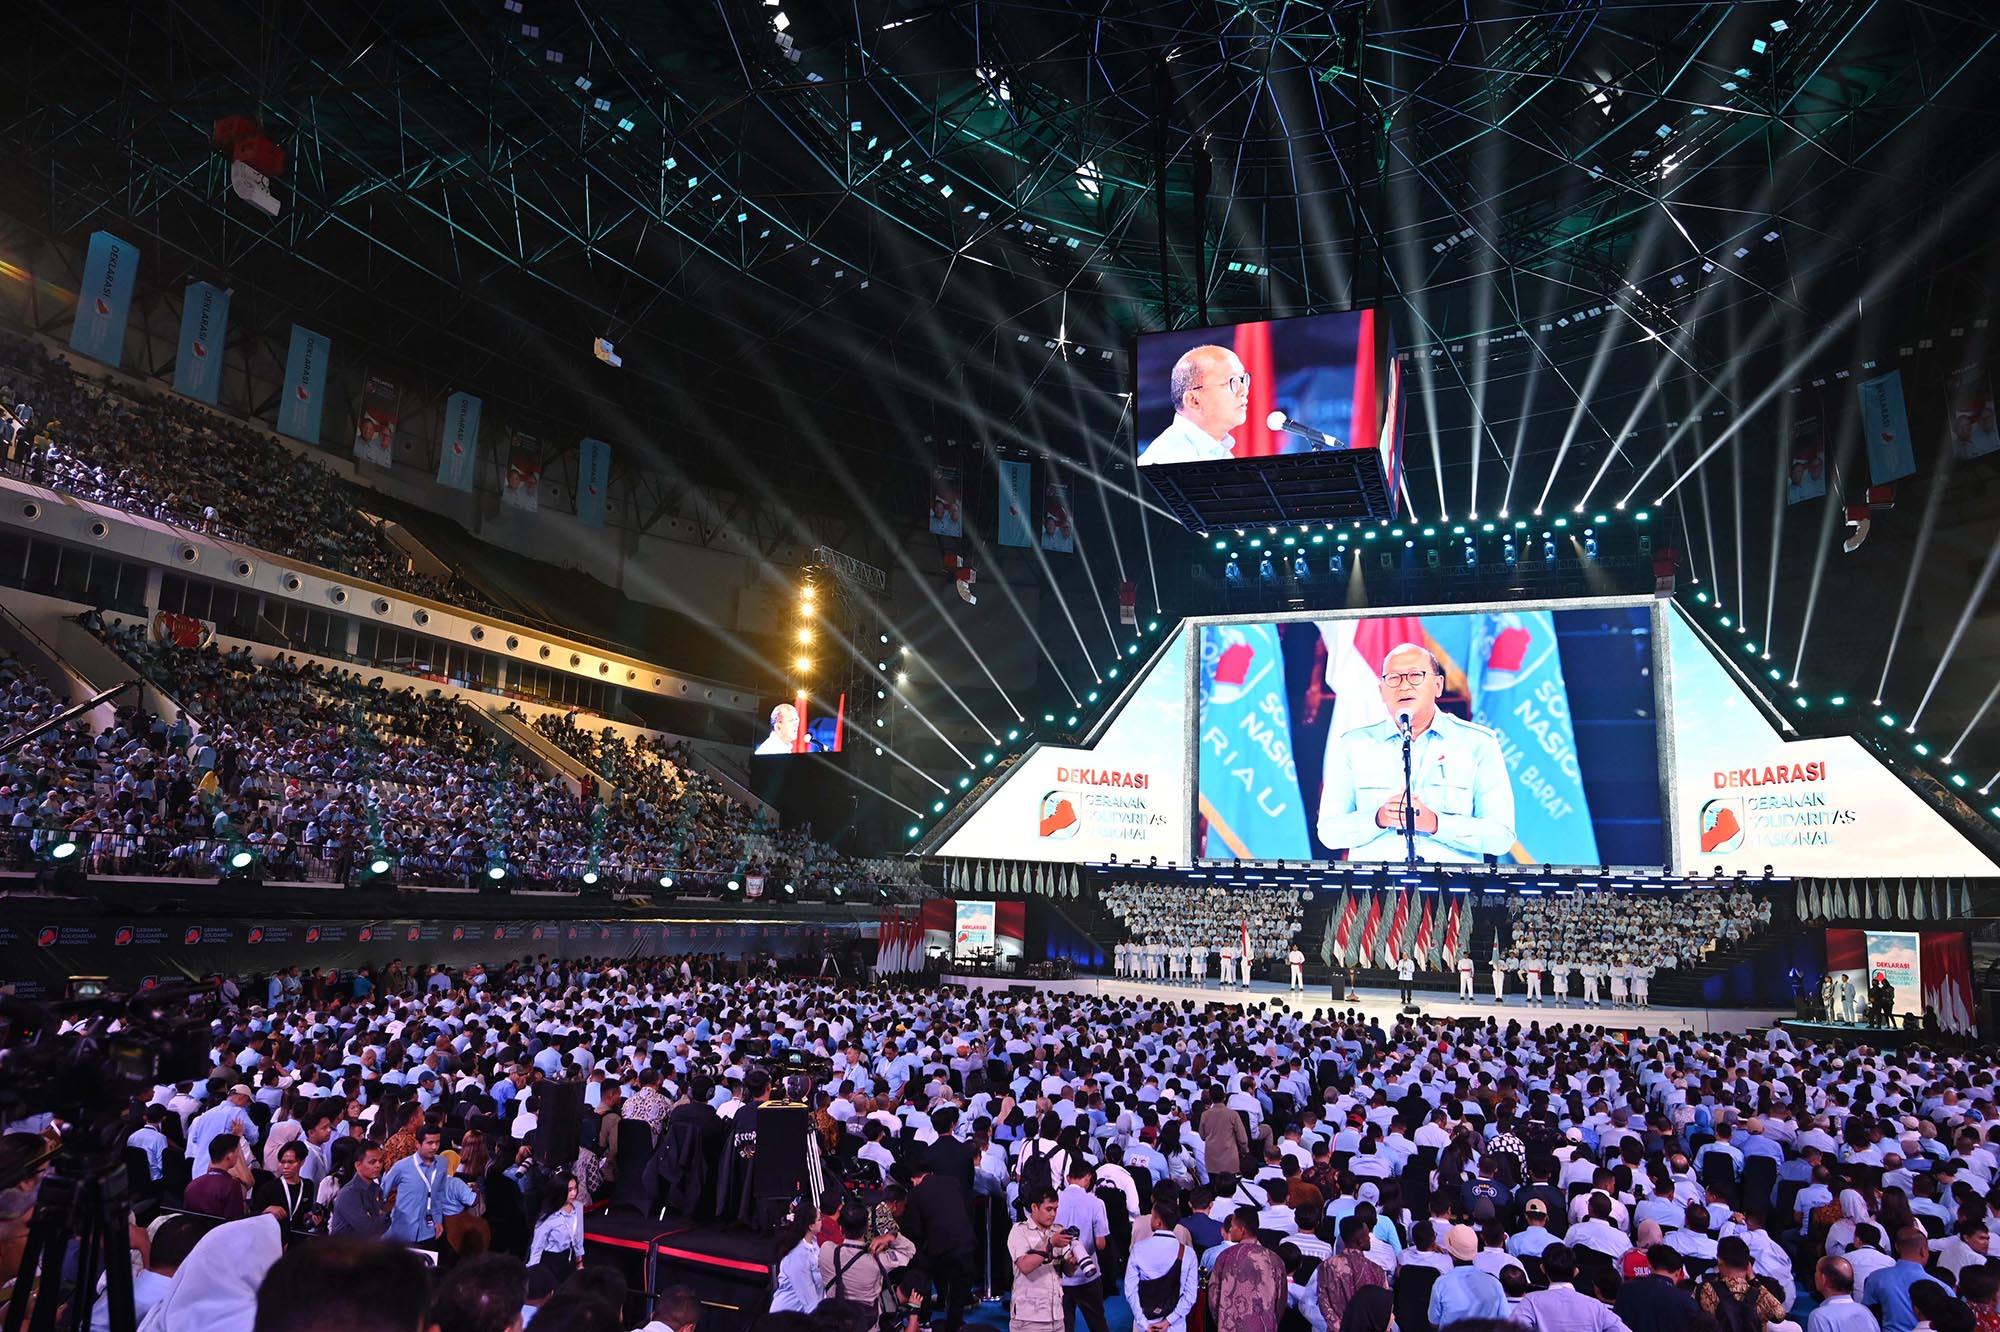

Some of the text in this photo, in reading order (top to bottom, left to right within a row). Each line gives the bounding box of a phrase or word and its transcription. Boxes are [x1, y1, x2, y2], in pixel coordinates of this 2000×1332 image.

[101, 244, 120, 299] DEKLARASI
[199, 290, 214, 341] DEKLARASI
[1057, 767, 1149, 789] DEKLARASI
[1202, 726, 1287, 818] RIAU
[1713, 761, 1826, 789] DEKLARASI
[1518, 765, 1574, 821] BARAT
[1086, 810, 1168, 826] OLIDARITAS
[1876, 961, 1910, 969] DEKLARASI
